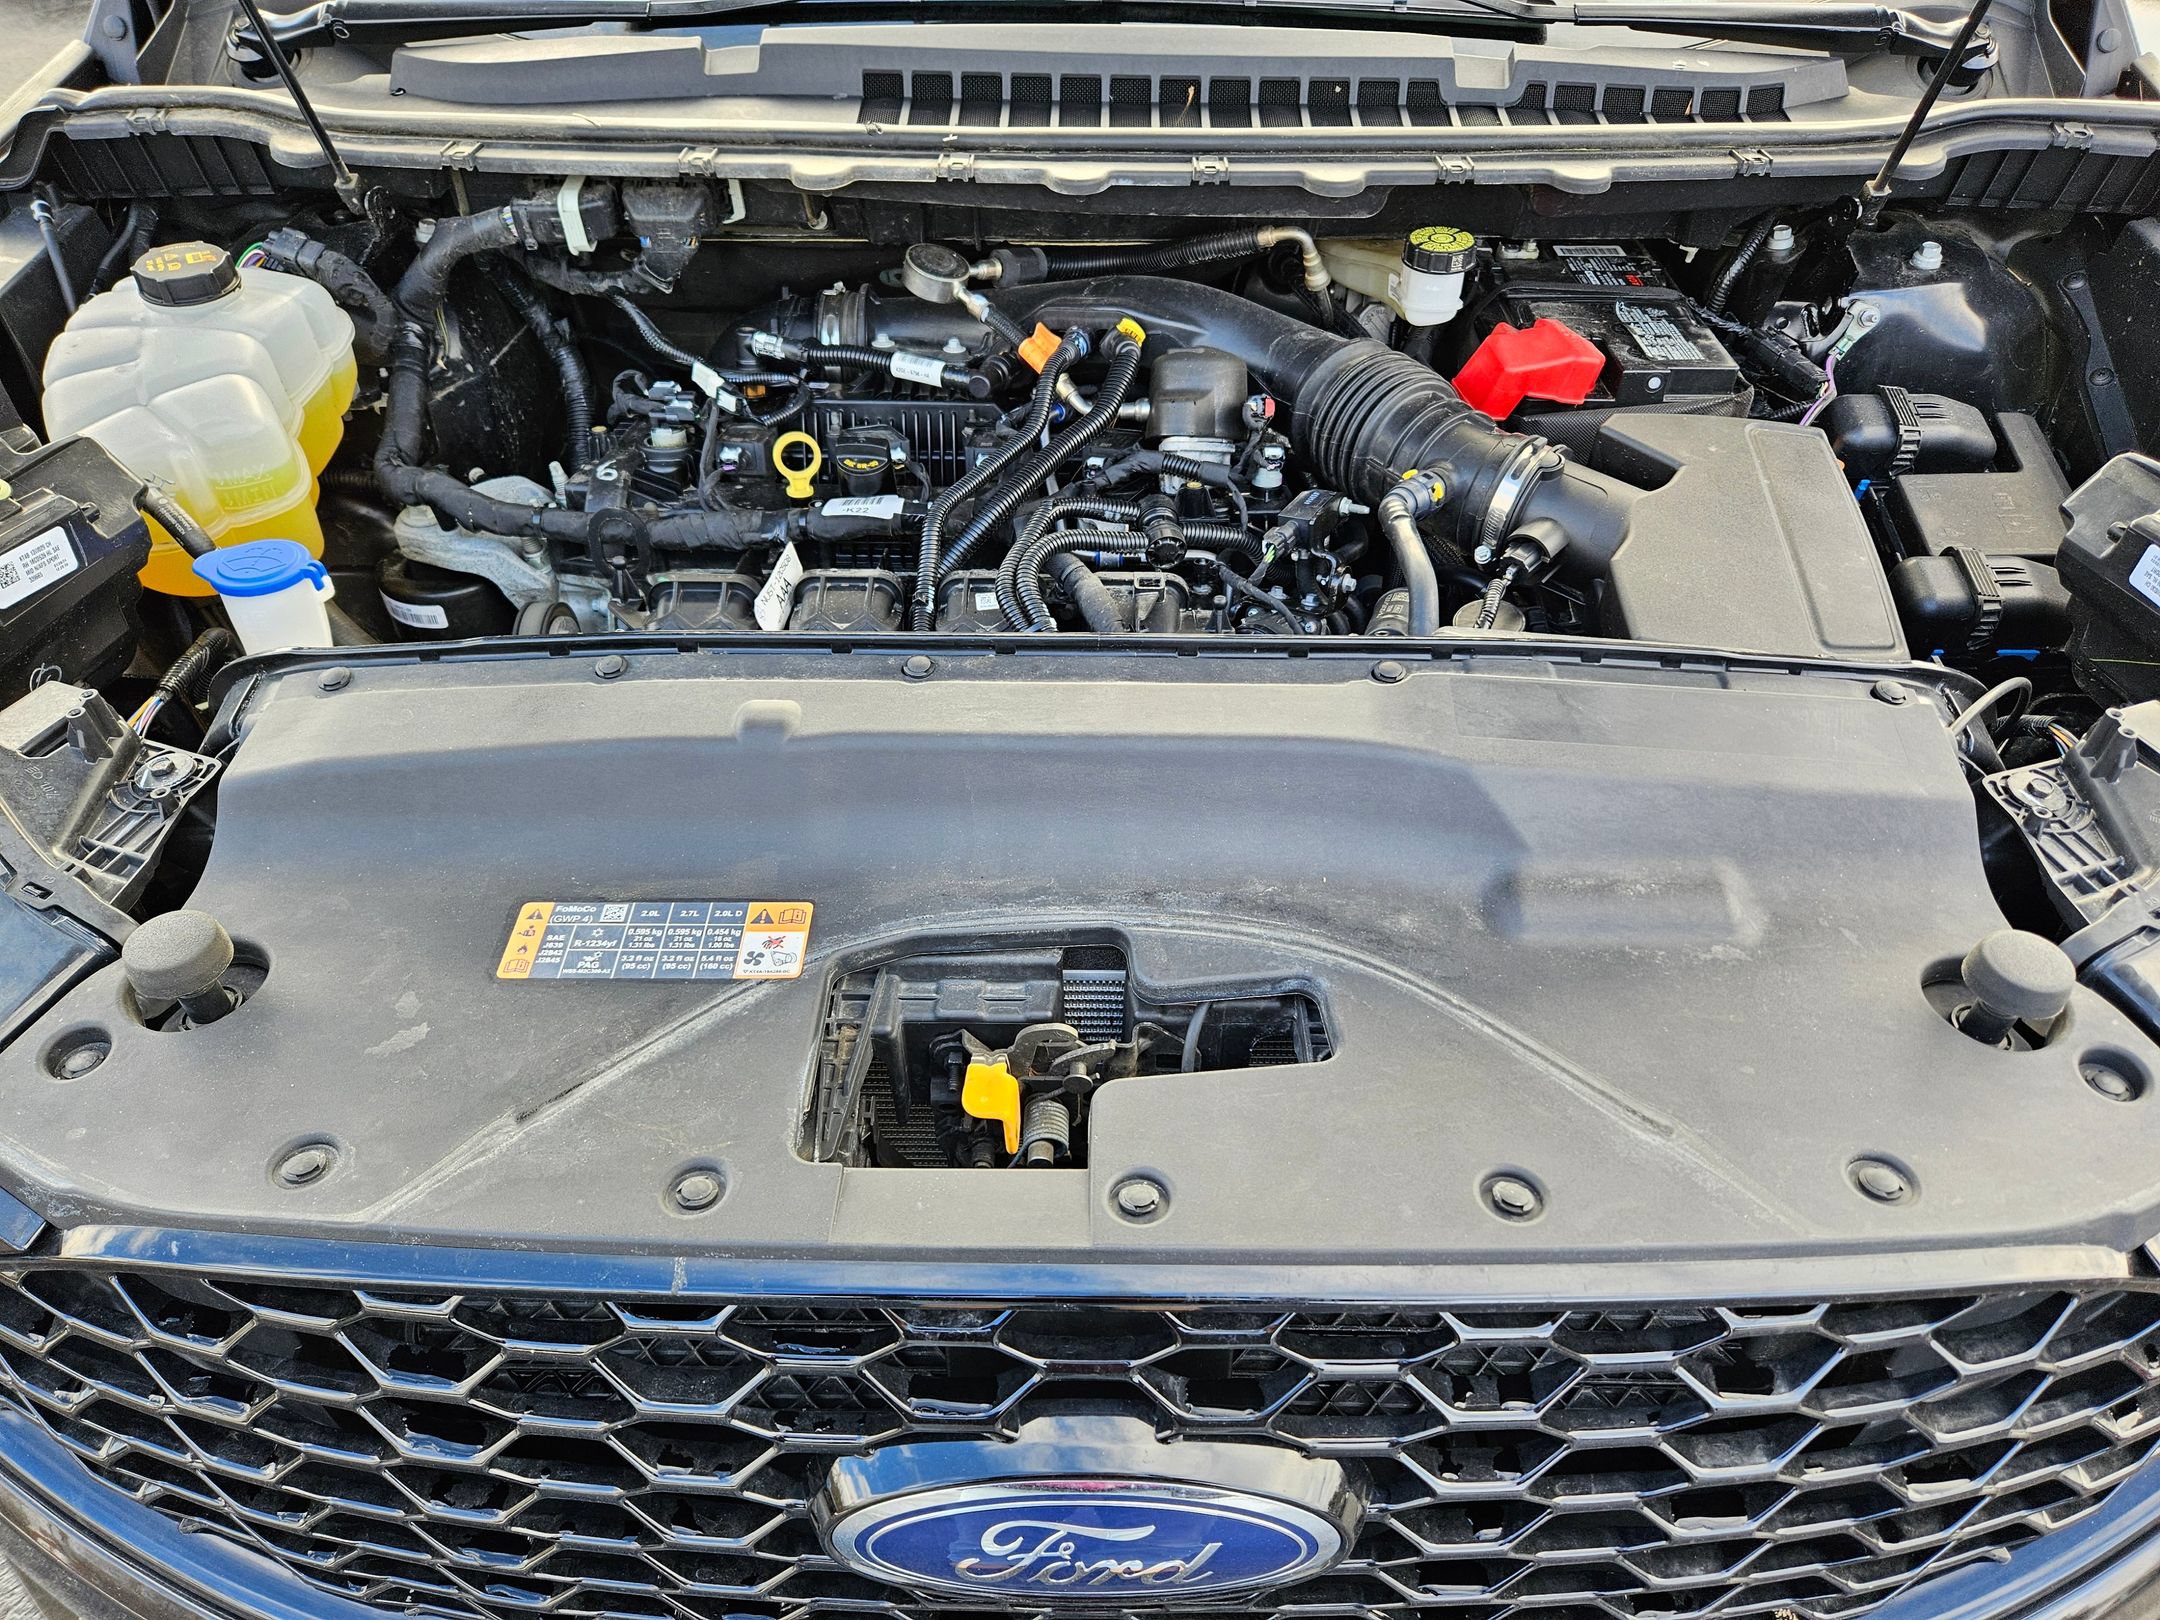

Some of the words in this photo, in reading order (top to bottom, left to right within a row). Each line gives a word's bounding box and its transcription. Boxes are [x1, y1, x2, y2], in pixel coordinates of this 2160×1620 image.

[777, 577, 792, 609] AAA
[550, 915, 581, 924] (GWP
[582, 915, 594, 923] 4)
[652, 928, 663, 937] kg
[691, 928, 703, 937] kg
[730, 928, 741, 937] kg
[574, 940, 618, 949] R-1234yf
[577, 961, 599, 969] PAG
[955, 1520, 1223, 1585] Ford
